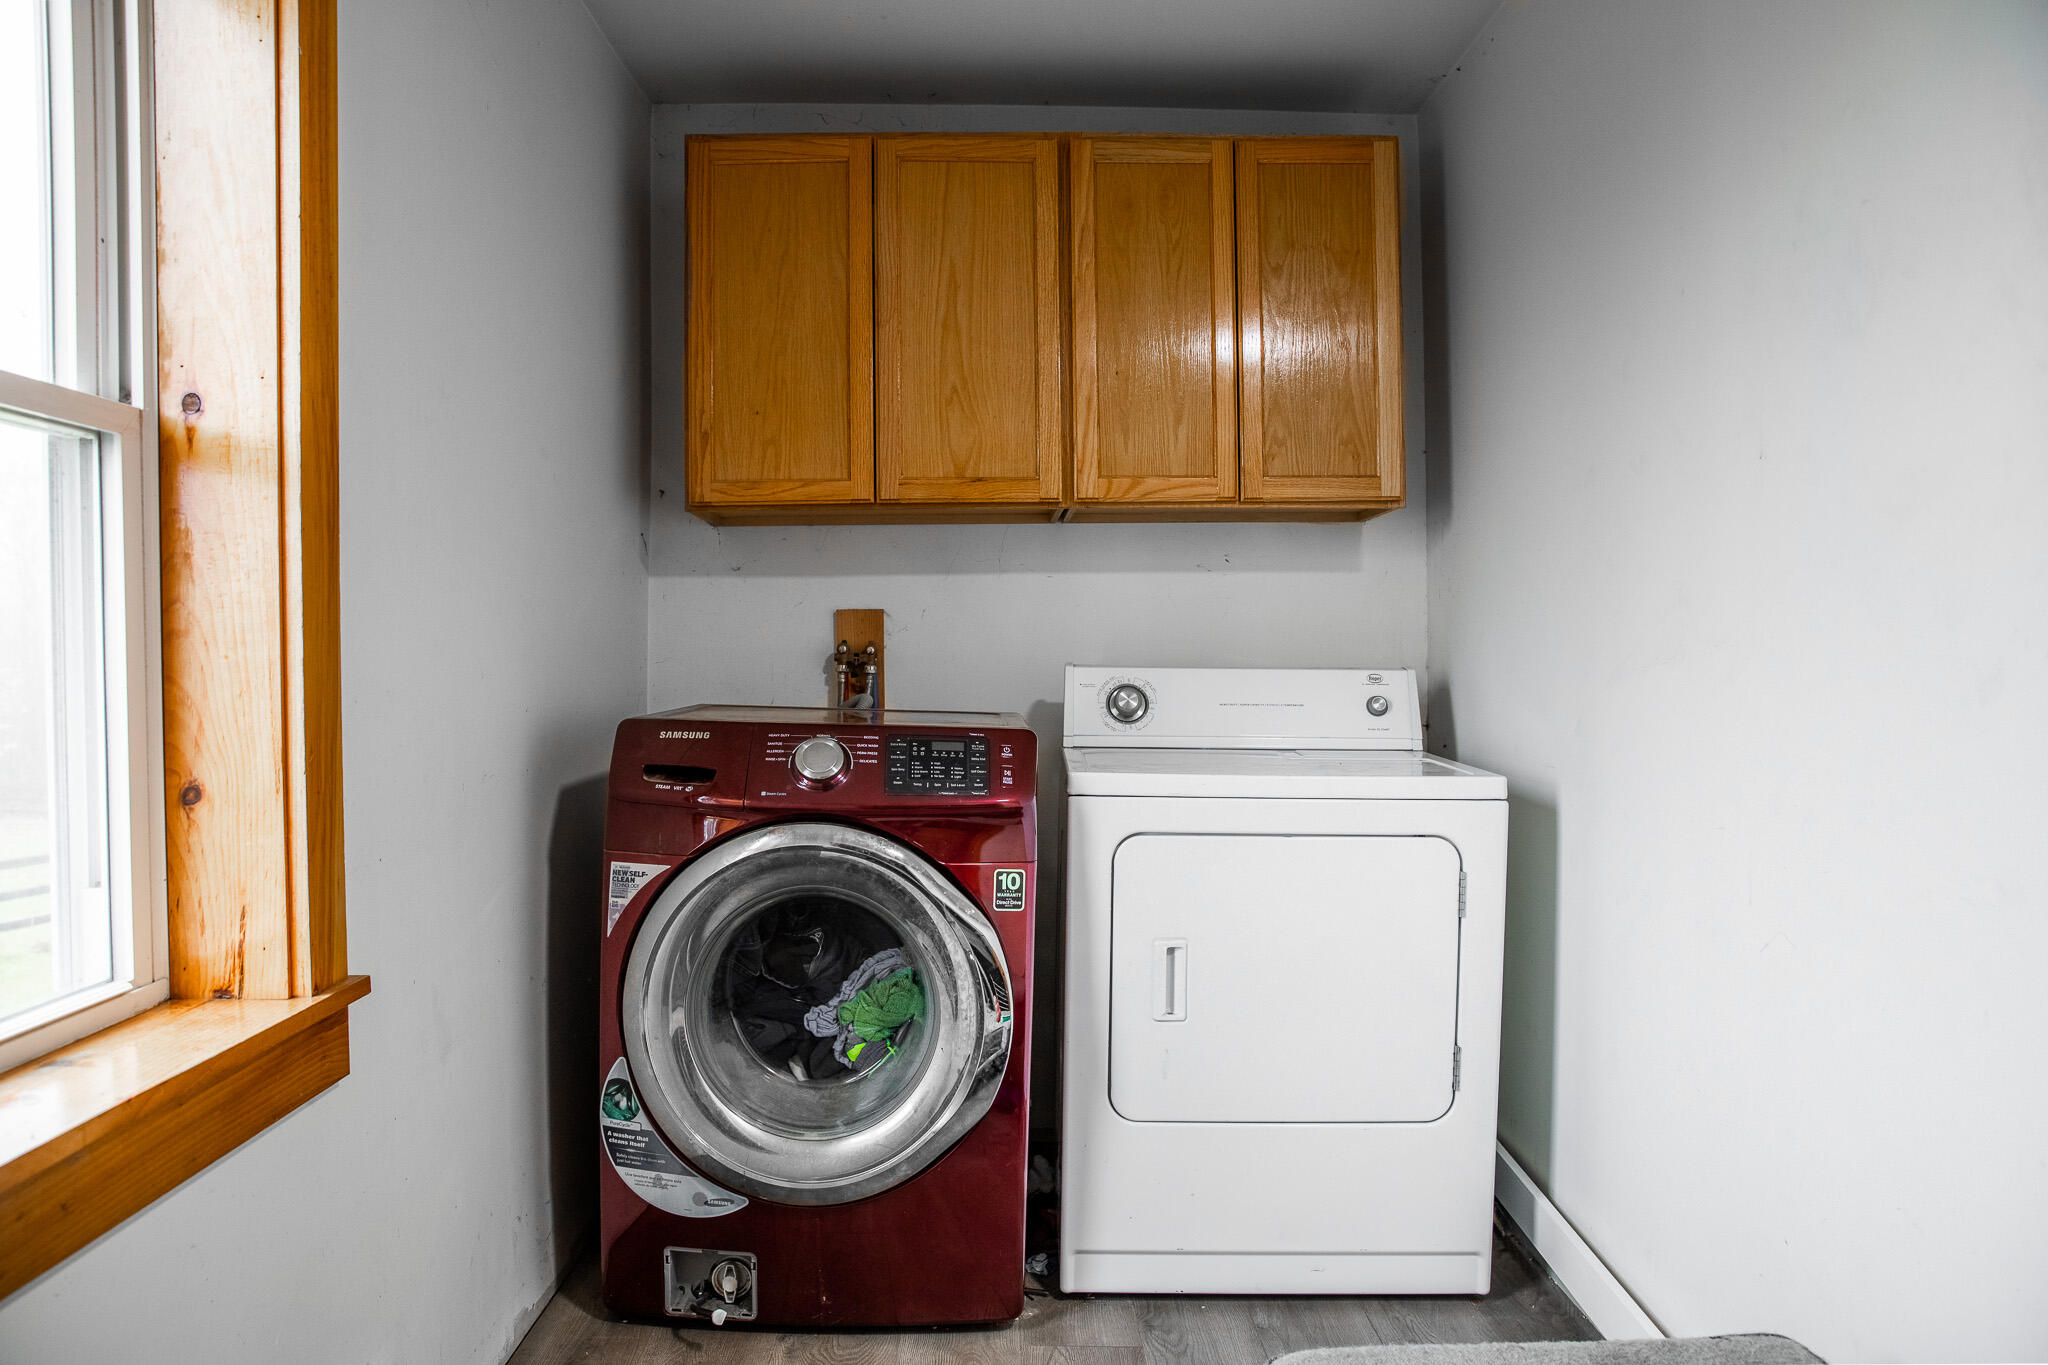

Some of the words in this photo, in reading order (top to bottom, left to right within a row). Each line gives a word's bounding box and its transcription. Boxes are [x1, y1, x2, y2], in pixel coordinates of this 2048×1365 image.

[659, 731, 710, 739] SAMSUNG
[628, 870, 648, 878] SELF-
[998, 872, 1021, 890] 10
[612, 1131, 635, 1140] washer
[636, 1134, 649, 1142] that
[629, 1140, 645, 1148] itself
